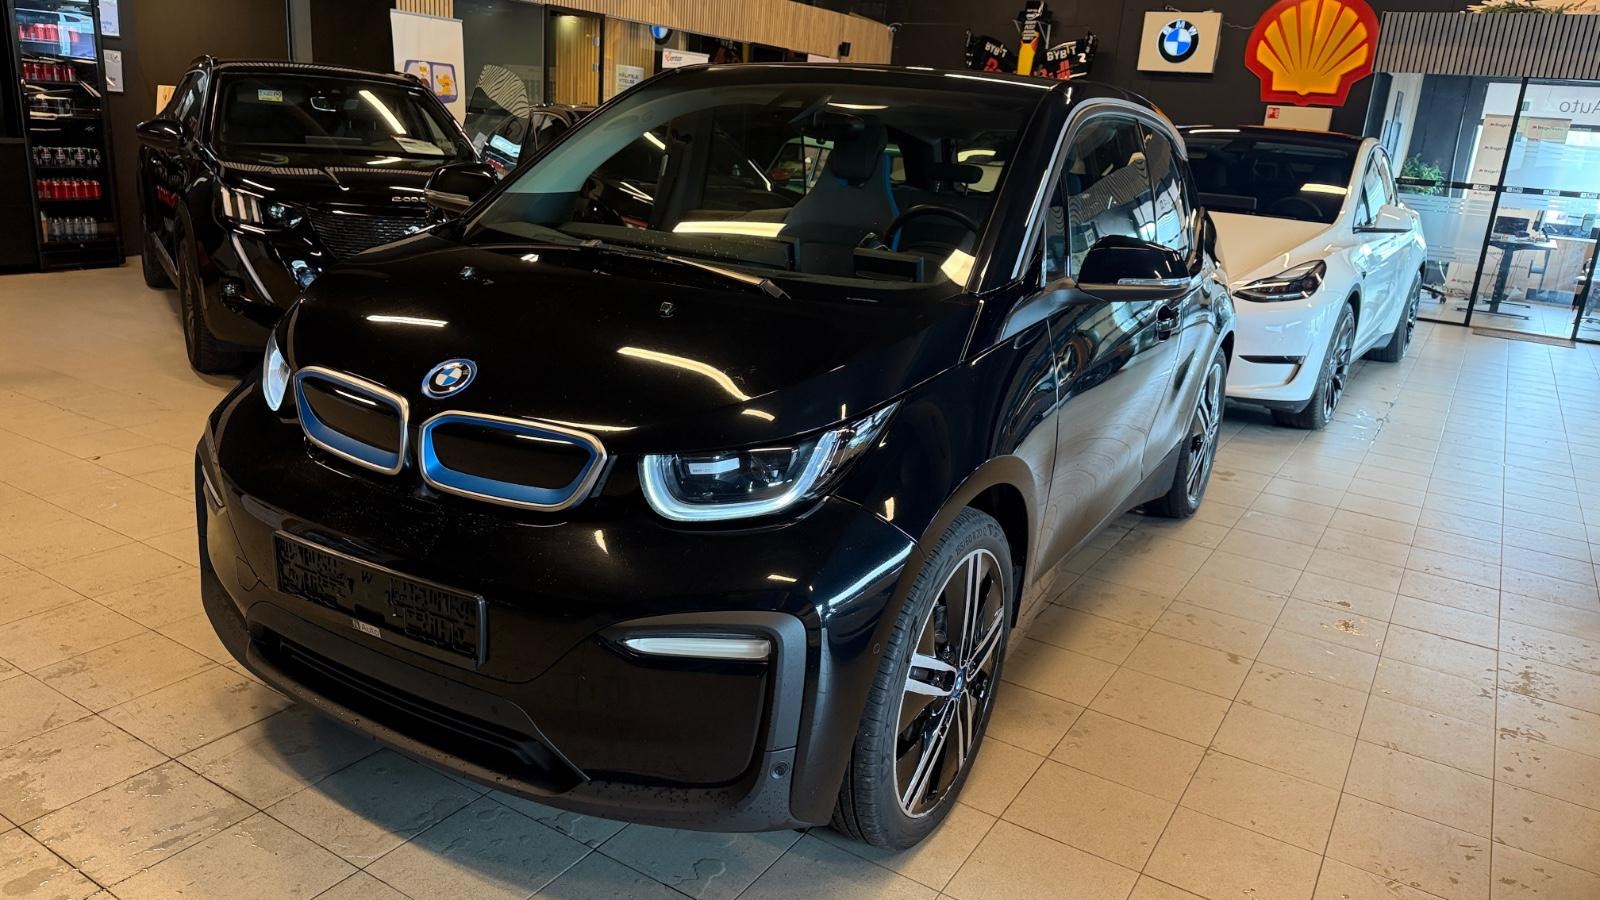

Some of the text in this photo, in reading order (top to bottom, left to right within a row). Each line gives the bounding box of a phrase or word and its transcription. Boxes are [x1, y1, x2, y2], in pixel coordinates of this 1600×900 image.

[1162, 20, 1198, 36] BMW
[984, 41, 1008, 58] BYBIT
[1046, 45, 1077, 62] BYBIT
